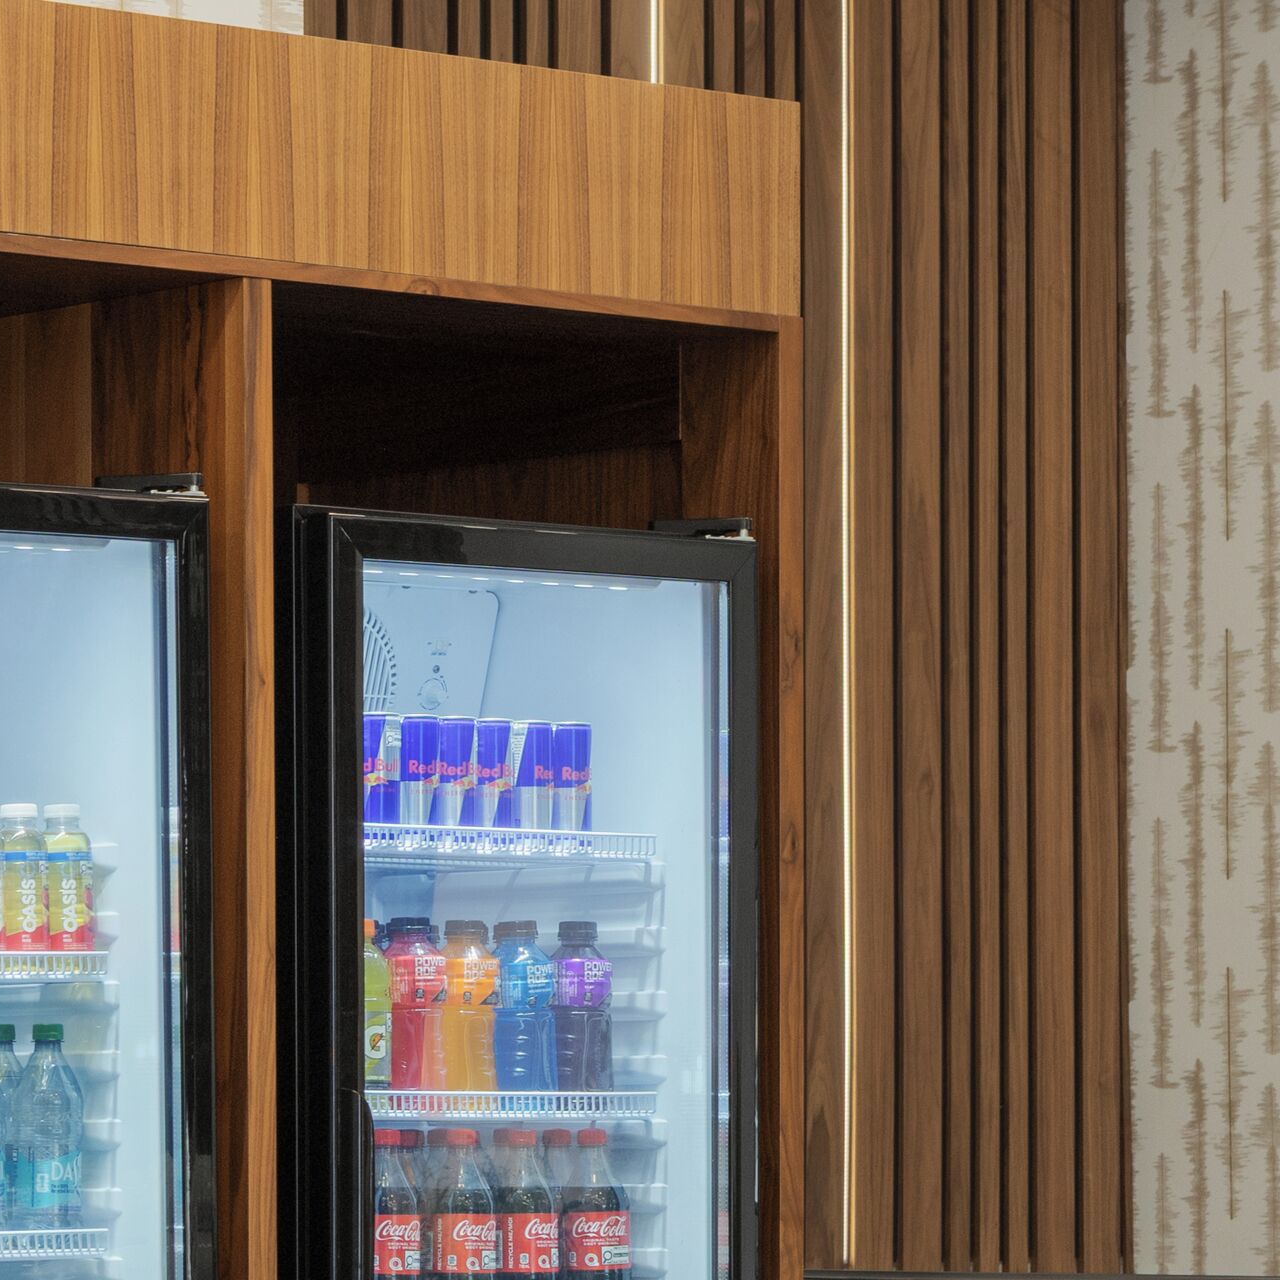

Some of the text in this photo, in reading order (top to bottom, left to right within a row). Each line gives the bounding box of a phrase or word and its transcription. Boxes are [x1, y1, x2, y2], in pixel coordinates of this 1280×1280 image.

[408, 759, 435, 774] Red
[437, 761, 467, 776] Red
[21, 878, 37, 933] OASIS
[62, 878, 78, 933] OASIS
[572, 1215, 627, 1238] Coca-Cola
